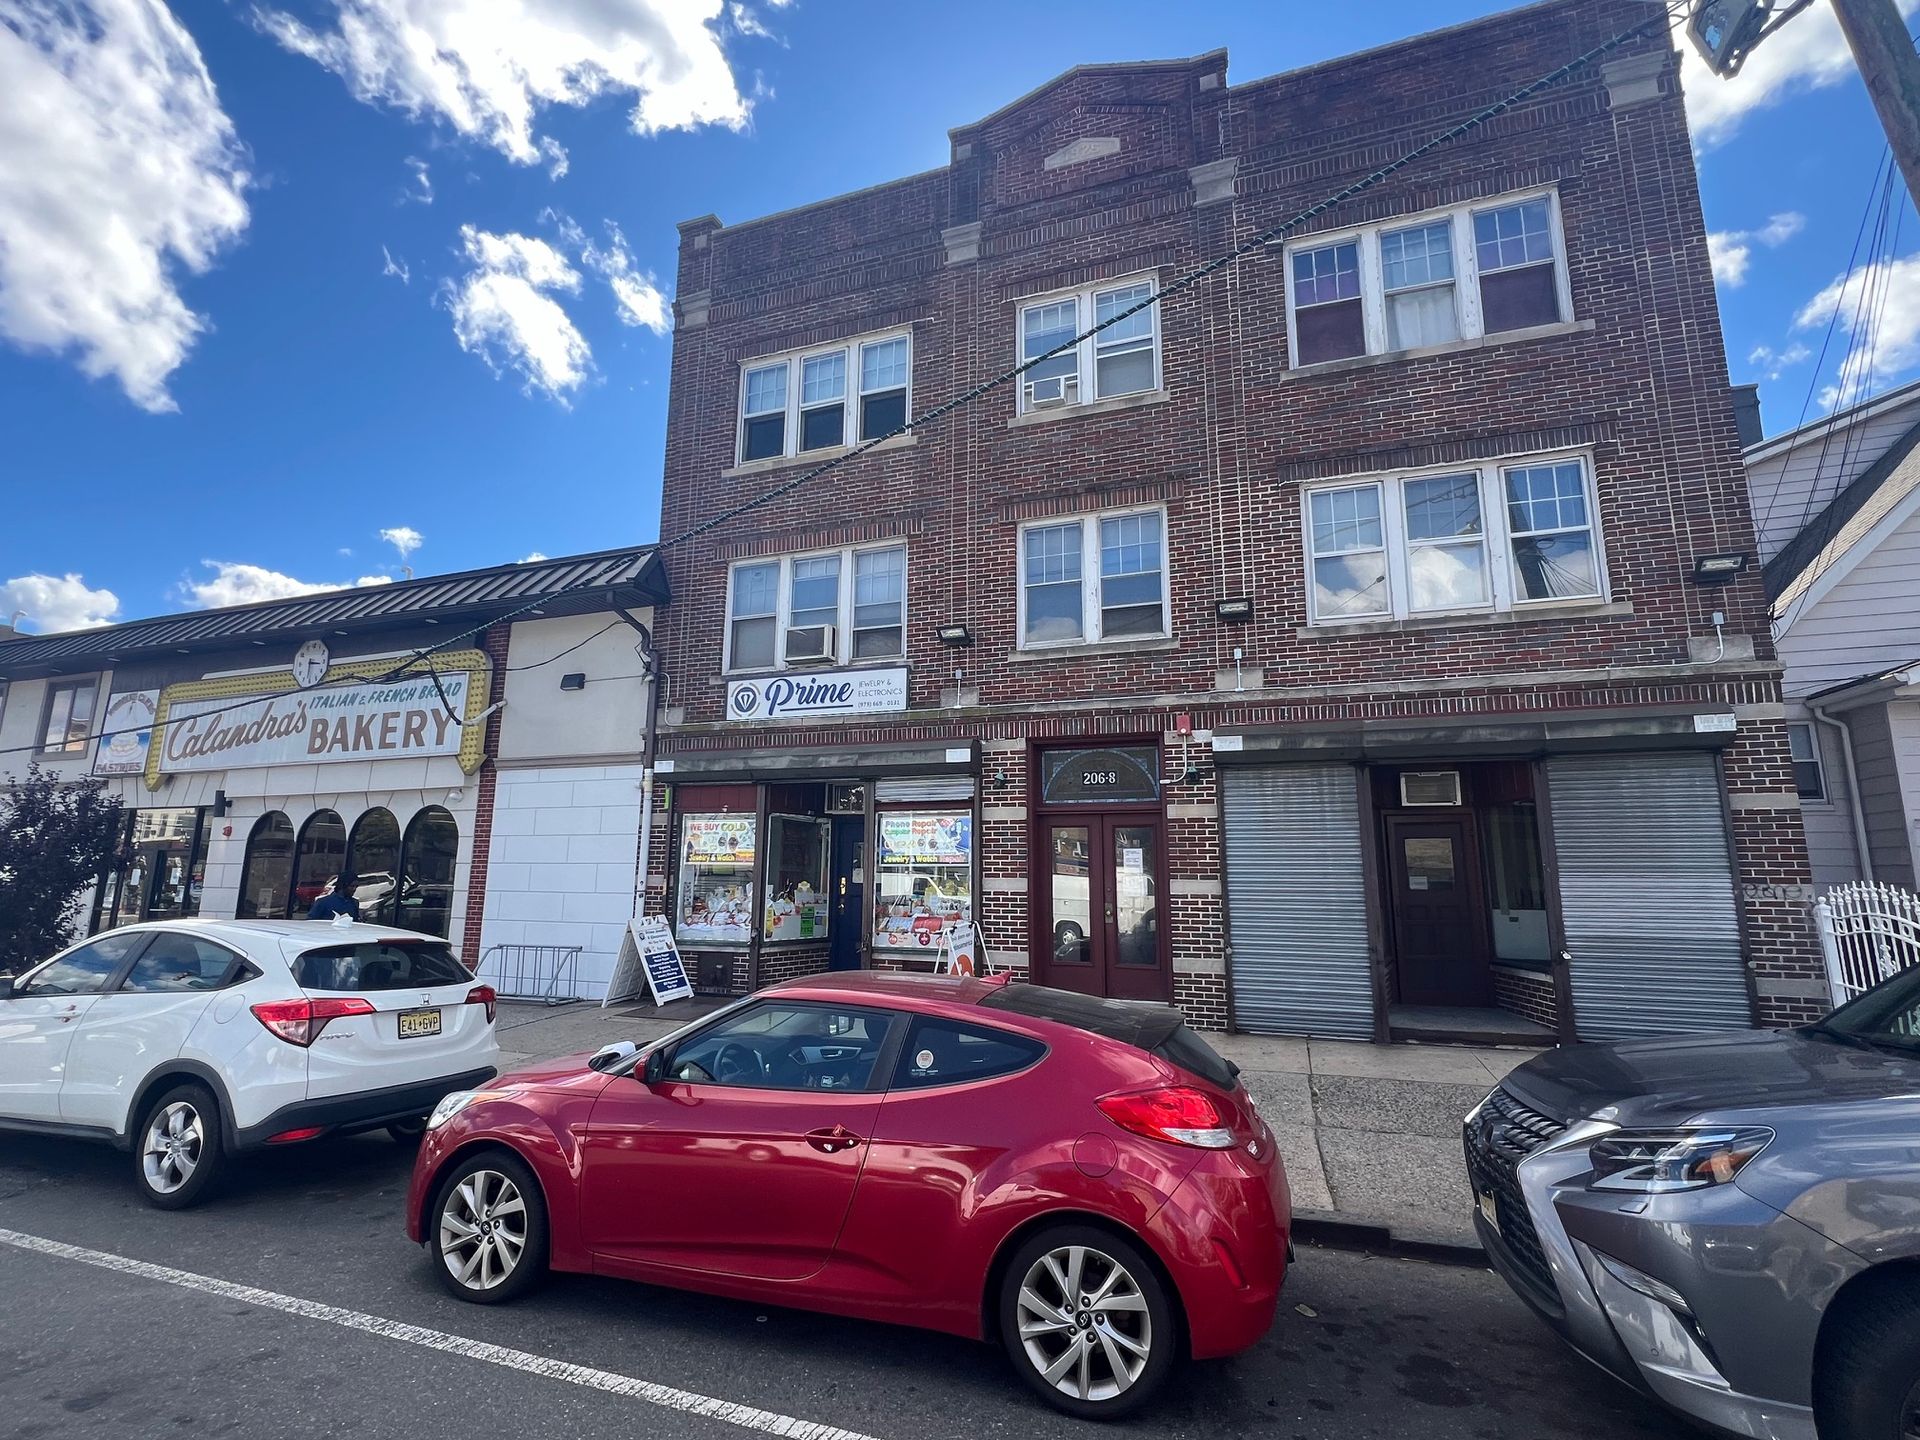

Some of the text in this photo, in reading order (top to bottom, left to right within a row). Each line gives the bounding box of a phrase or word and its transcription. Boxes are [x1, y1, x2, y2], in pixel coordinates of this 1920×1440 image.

[309, 692, 360, 709] ITALIAN
[359, 695, 367, 705] &
[367, 687, 418, 704] FRENCH
[765, 677, 854, 716] Prime
[858, 687, 903, 698] ELECTRONICS
[167, 699, 308, 762] Calandra's
[307, 706, 458, 754] BAKERY
[689, 822, 747, 832] WE BUY GOLD
[883, 855, 910, 864] Jewelry
[915, 855, 938, 863] Watch
